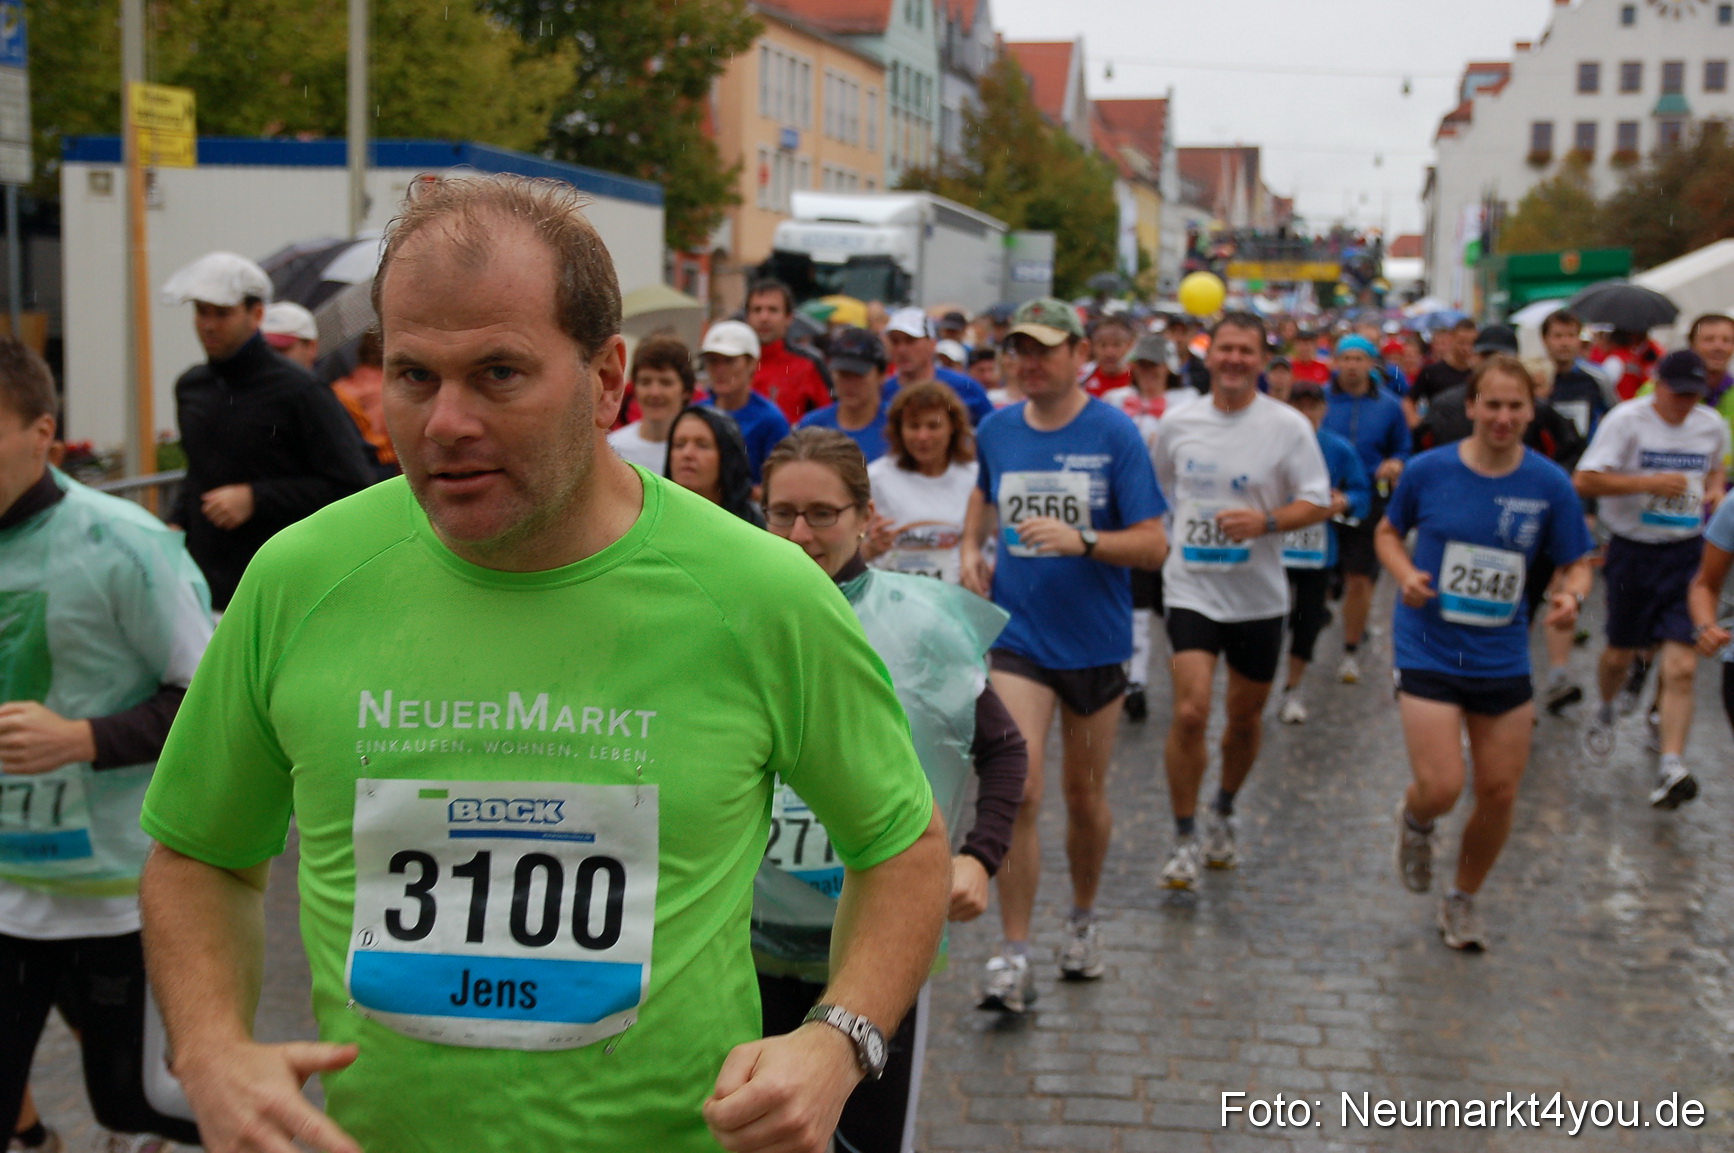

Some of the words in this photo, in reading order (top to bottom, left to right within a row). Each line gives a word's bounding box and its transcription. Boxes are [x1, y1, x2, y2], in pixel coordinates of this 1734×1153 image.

[1008, 495, 1079, 525] 2566
[1449, 565, 1516, 601] 2548
[355, 739, 473, 754] EINKAUFEN.
[485, 741, 579, 758] WOHNEN.
[589, 745, 655, 764] LEBEN.
[0, 781, 67, 828] 77
[448, 798, 566, 825] BOCK
[384, 849, 627, 951] 3100
[450, 969, 538, 1010] Jens
